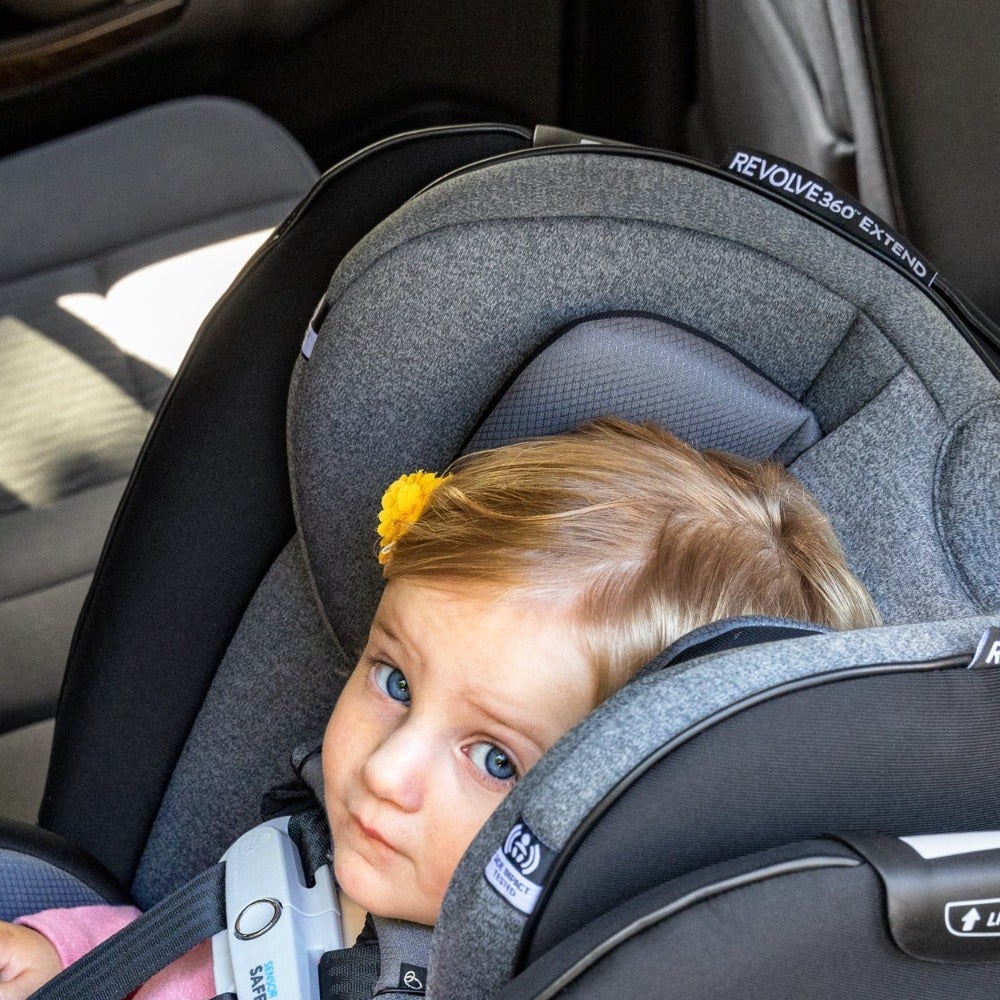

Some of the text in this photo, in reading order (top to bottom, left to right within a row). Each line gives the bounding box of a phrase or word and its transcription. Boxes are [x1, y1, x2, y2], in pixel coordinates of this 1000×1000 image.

[859, 216, 927, 278] EXTEND
[493, 870, 516, 896] TESTED
[263, 960, 278, 1000] SENSOR
